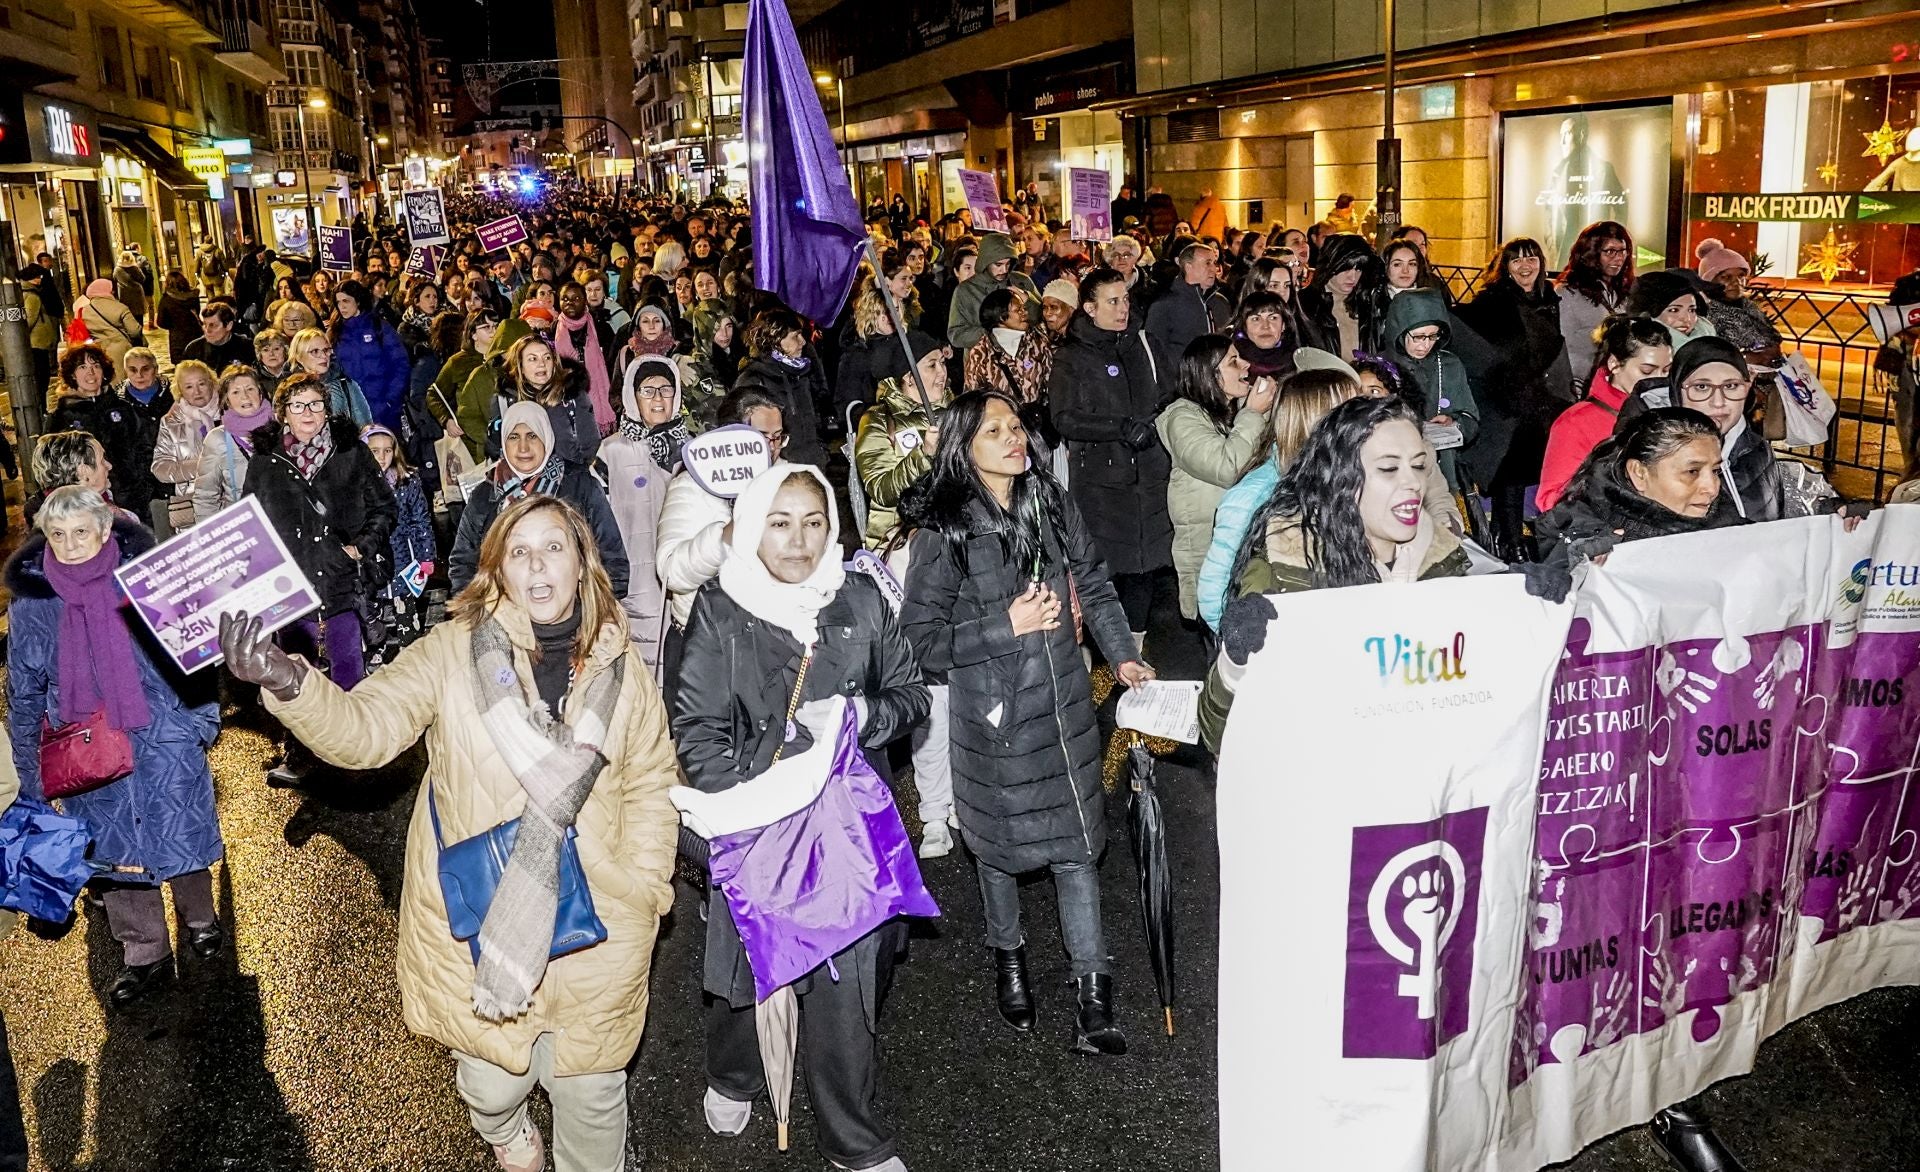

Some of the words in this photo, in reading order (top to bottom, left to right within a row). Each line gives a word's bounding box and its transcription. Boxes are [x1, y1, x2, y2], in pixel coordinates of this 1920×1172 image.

[1035, 91, 1054, 110] pablo
[1077, 87, 1097, 99] shoes
[191, 165, 219, 173] ORO
[1705, 196, 1769, 218] BLACK
[1769, 195, 1851, 219] FRIDAY
[321, 227, 343, 237] NAHI
[321, 235, 333, 244] KO
[322, 243, 330, 251] A
[322, 251, 335, 260] DA
[412, 253, 425, 262] CA
[689, 447, 709, 460] YO
[711, 444, 733, 458] ME
[734, 440, 763, 456] UNO
[711, 469, 728, 483] AL
[728, 466, 754, 481] 25N
[126, 567, 151, 586] DESDE
[150, 560, 166, 573] LOS
[165, 539, 199, 564] GRUPOS
[198, 533, 211, 545] DE
[212, 511, 253, 540] MUJERES
[185, 551, 235, 581] COMPARTIR
[234, 537, 258, 554] ESTE
[145, 578, 157, 589] DE
[167, 579, 204, 605] MENSAJE
[182, 615, 216, 643] 25N
[1364, 631, 1467, 686] Vital
[1431, 690, 1493, 709] FUNDAZIOA
[1847, 678, 1904, 707] MOS
[1696, 719, 1772, 757] SOLAS
[1539, 772, 1638, 822] IZIZAK!
[1535, 936, 1619, 985] JUNTAS
